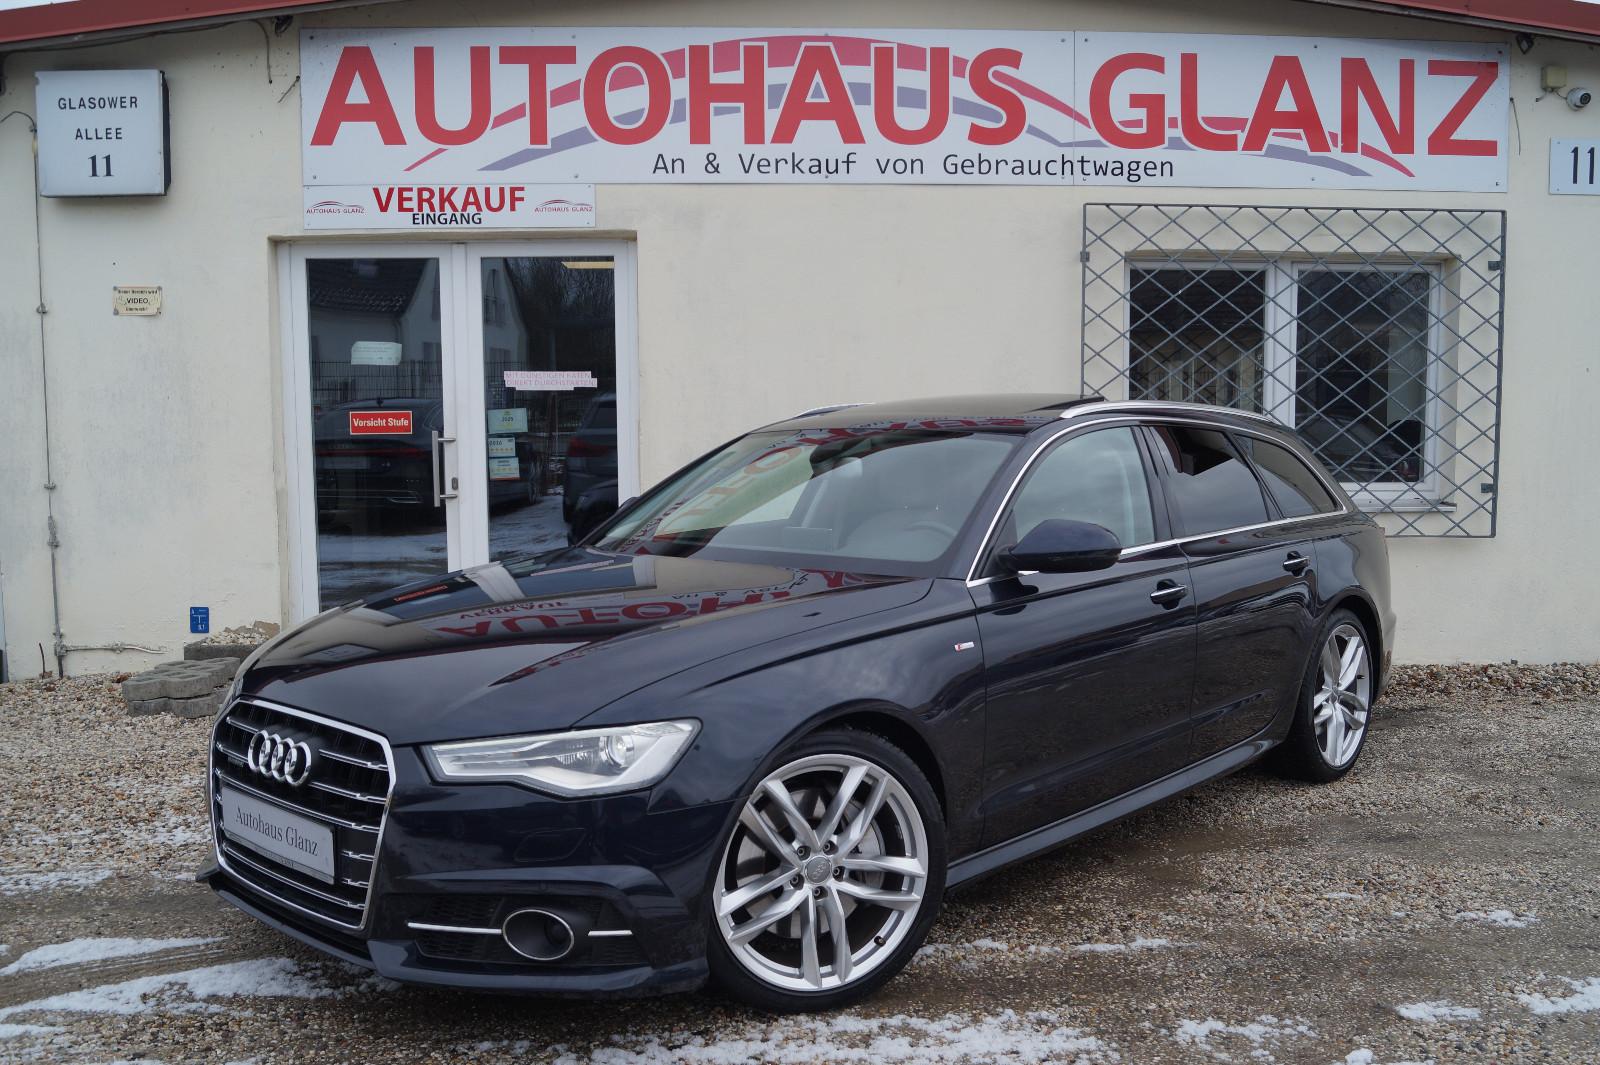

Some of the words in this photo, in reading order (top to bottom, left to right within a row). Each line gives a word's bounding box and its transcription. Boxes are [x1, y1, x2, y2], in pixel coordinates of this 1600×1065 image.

[57, 96, 138, 110] GLASOWER
[310, 44, 1027, 146] AUTOHAUS
[1089, 52, 1499, 157] GLANZ
[75, 127, 123, 140] ALLEE
[87, 153, 115, 178] 11
[652, 153, 685, 175] An
[704, 152, 721, 175] &
[738, 151, 857, 175] Verkauf
[876, 157, 924, 175] von
[943, 153, 1174, 182] Gebrauchtwagen
[1570, 146, 1595, 185] 11
[372, 186, 525, 213] VERKAUF
[412, 212, 482, 225] EINGANG
[352, 418, 386, 427] Vorsicht
[387, 417, 409, 427] Stufe
[236, 804, 283, 842] Autohaus
[285, 826, 318, 857] Glanz
